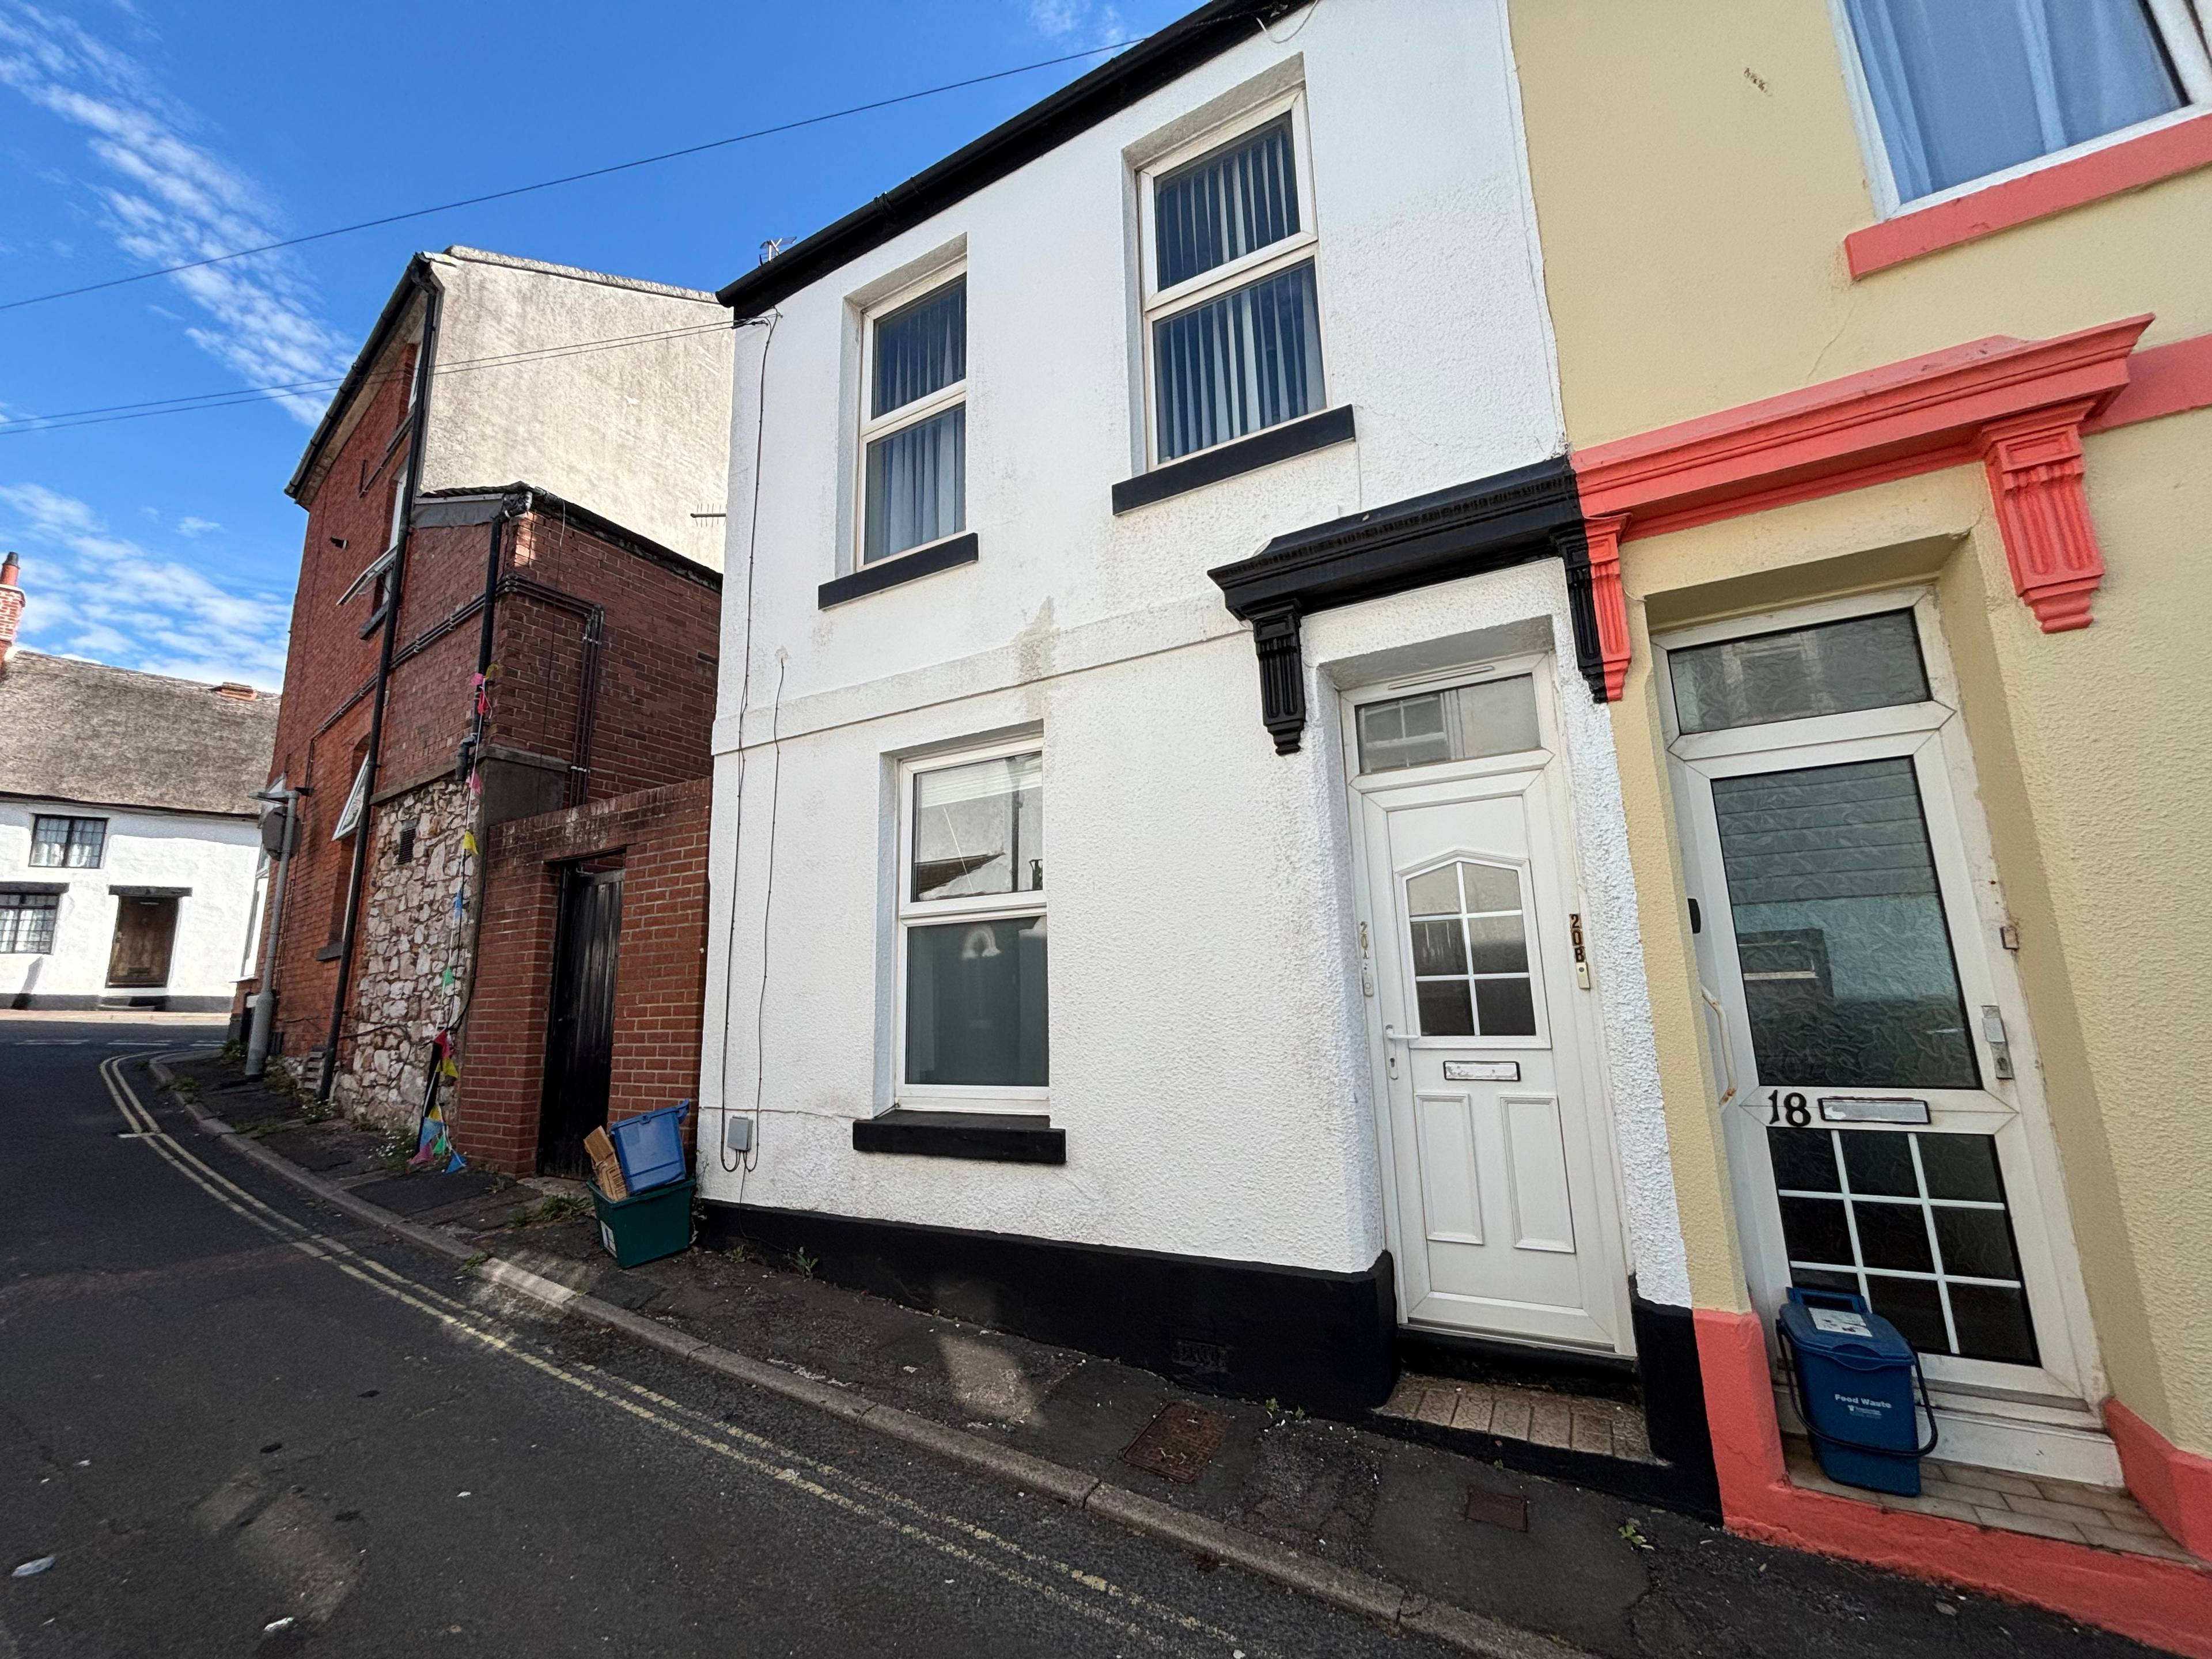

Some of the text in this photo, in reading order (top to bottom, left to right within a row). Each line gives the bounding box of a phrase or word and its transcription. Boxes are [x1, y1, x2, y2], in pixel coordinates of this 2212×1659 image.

[1571, 914, 1585, 963] 20B
[1768, 1089, 1811, 1127] 18
[1835, 1393, 1892, 1408] Food Waste
